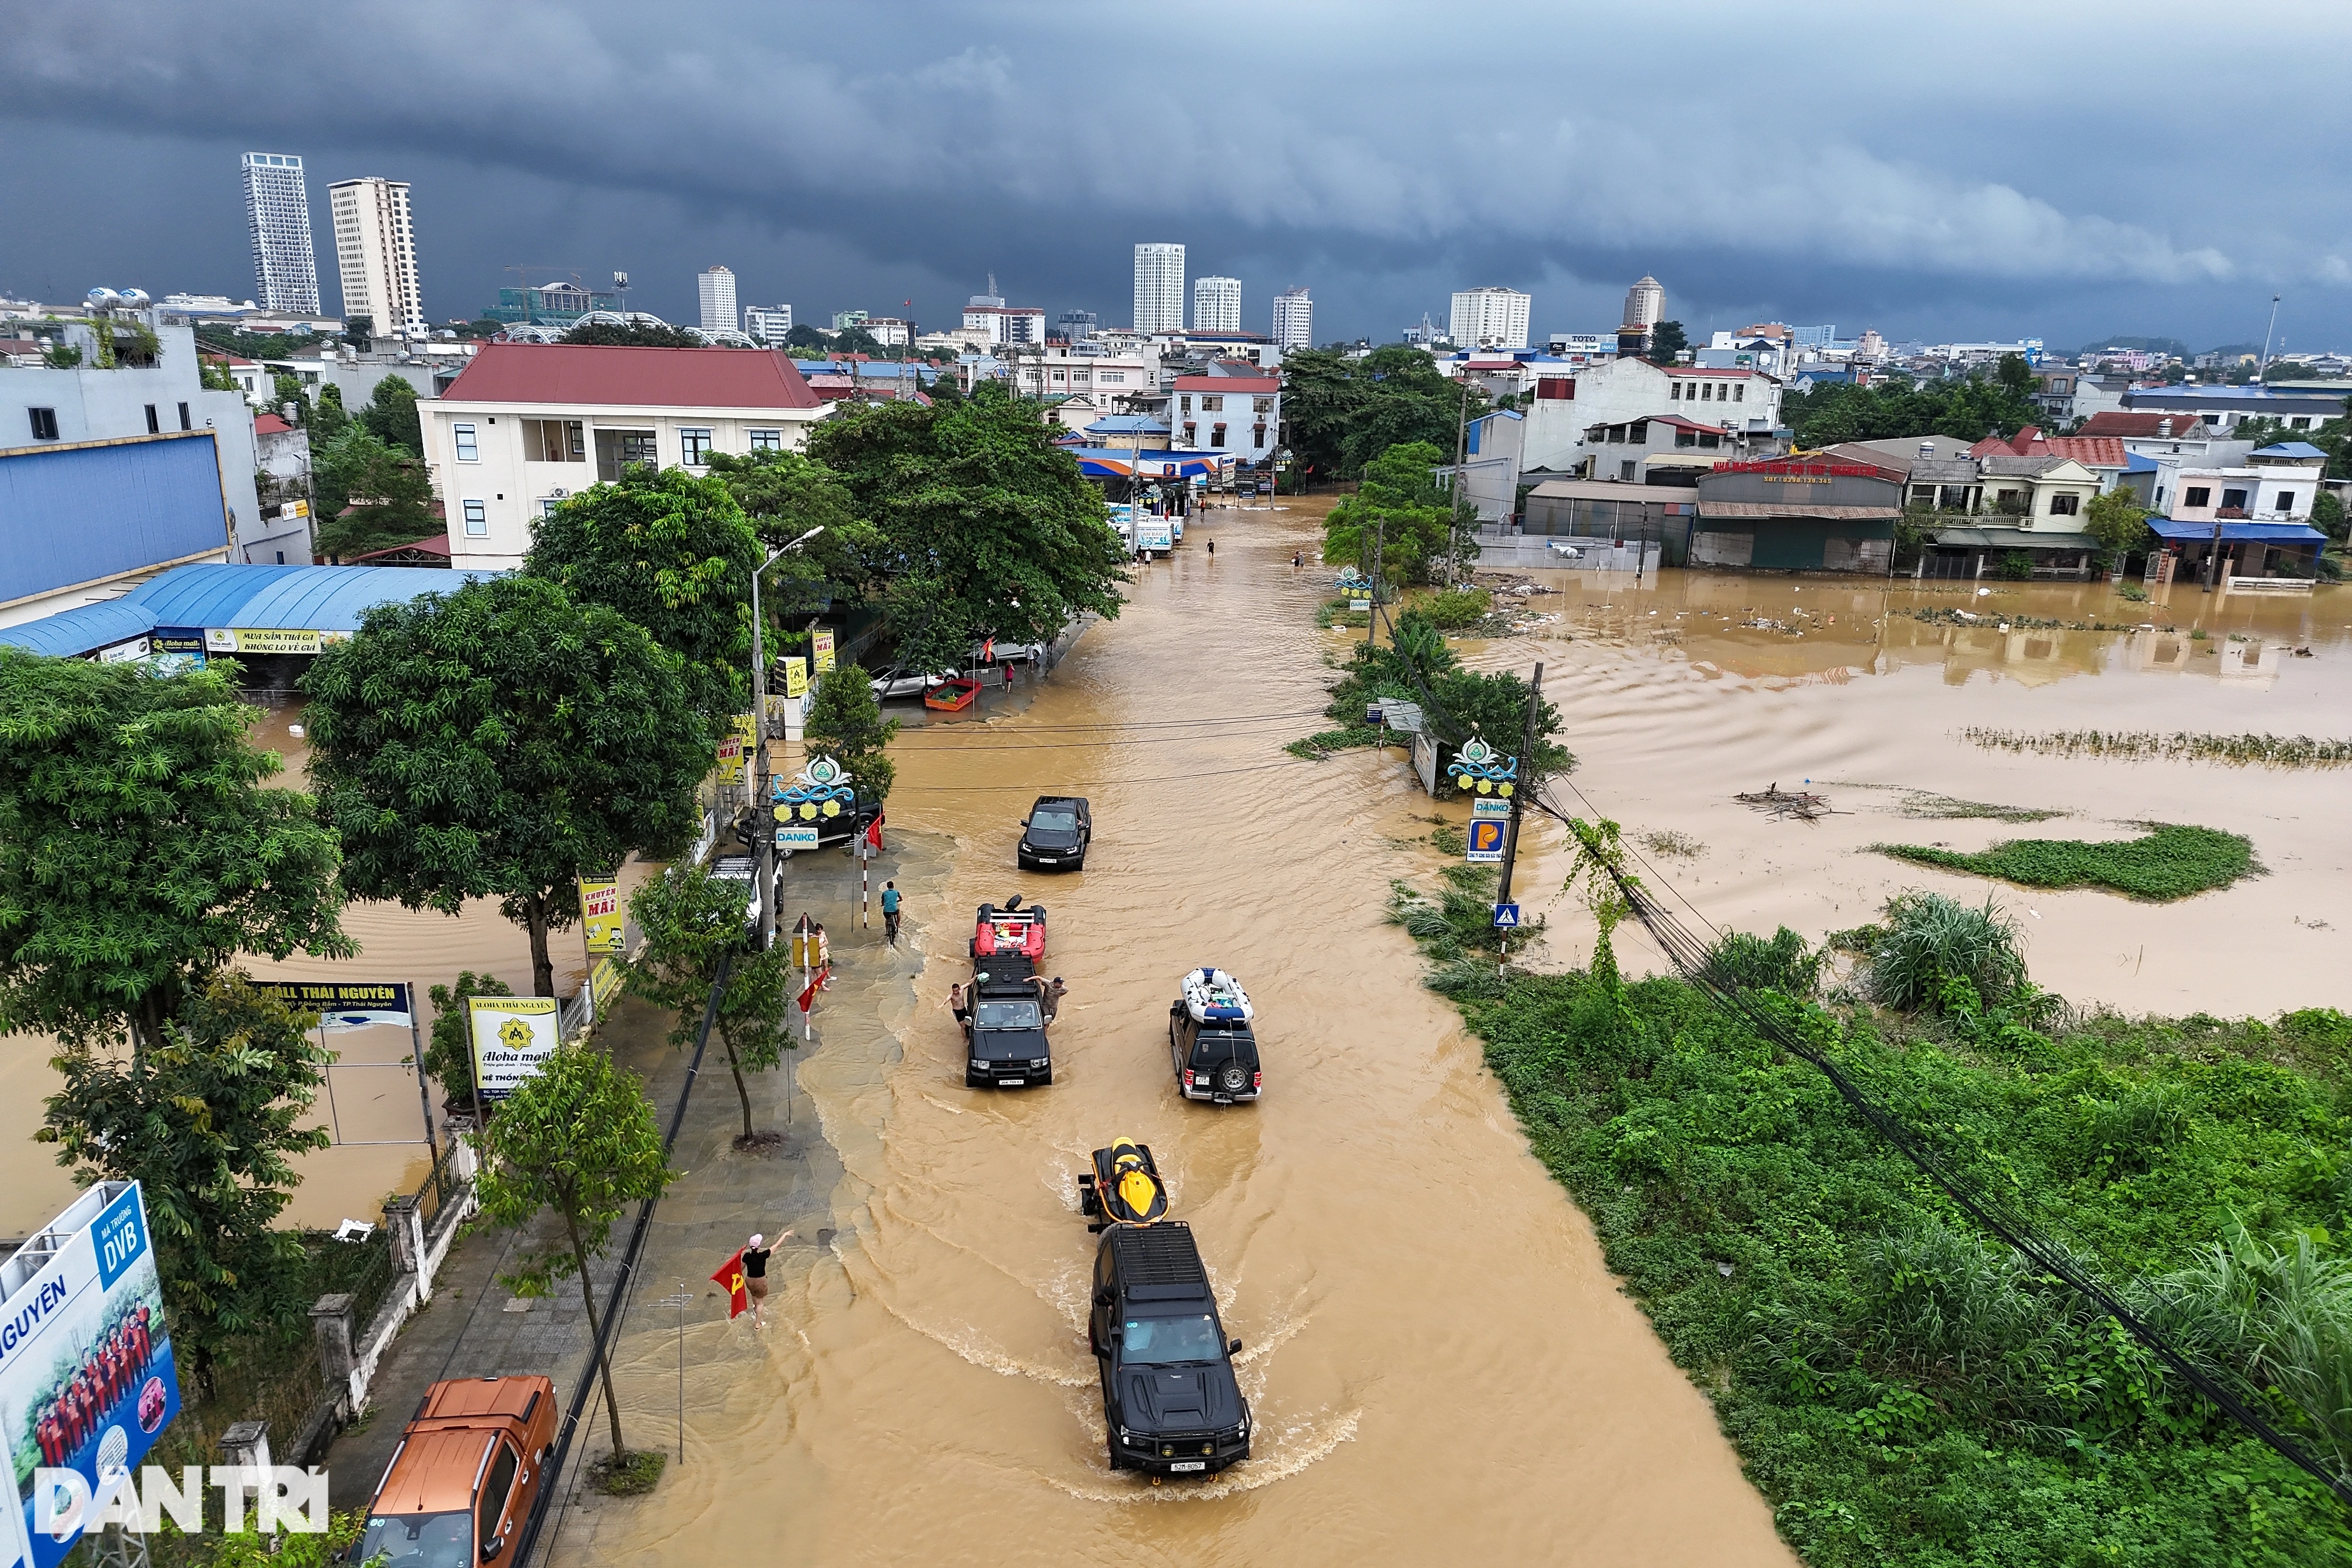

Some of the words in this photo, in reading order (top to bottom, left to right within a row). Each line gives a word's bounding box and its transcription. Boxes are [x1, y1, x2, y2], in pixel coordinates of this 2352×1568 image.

[244, 642, 274, 650] KHÔNG
[300, 643, 316, 651] GIÁ
[1476, 803, 1508, 811] DANKO
[777, 833, 816, 841] DANKO
[585, 886, 617, 901] KHUYẾN
[300, 986, 335, 999] THÁI
[338, 986, 395, 999] NGUYÊN
[482, 1051, 518, 1061] Aloha
[522, 1051, 550, 1061] mall
[482, 1073, 493, 1083] HỆ
[101, 1227, 111, 1240] MÃ
[104, 1221, 137, 1274] DVB
[0, 1274, 66, 1359] GUYÊN
